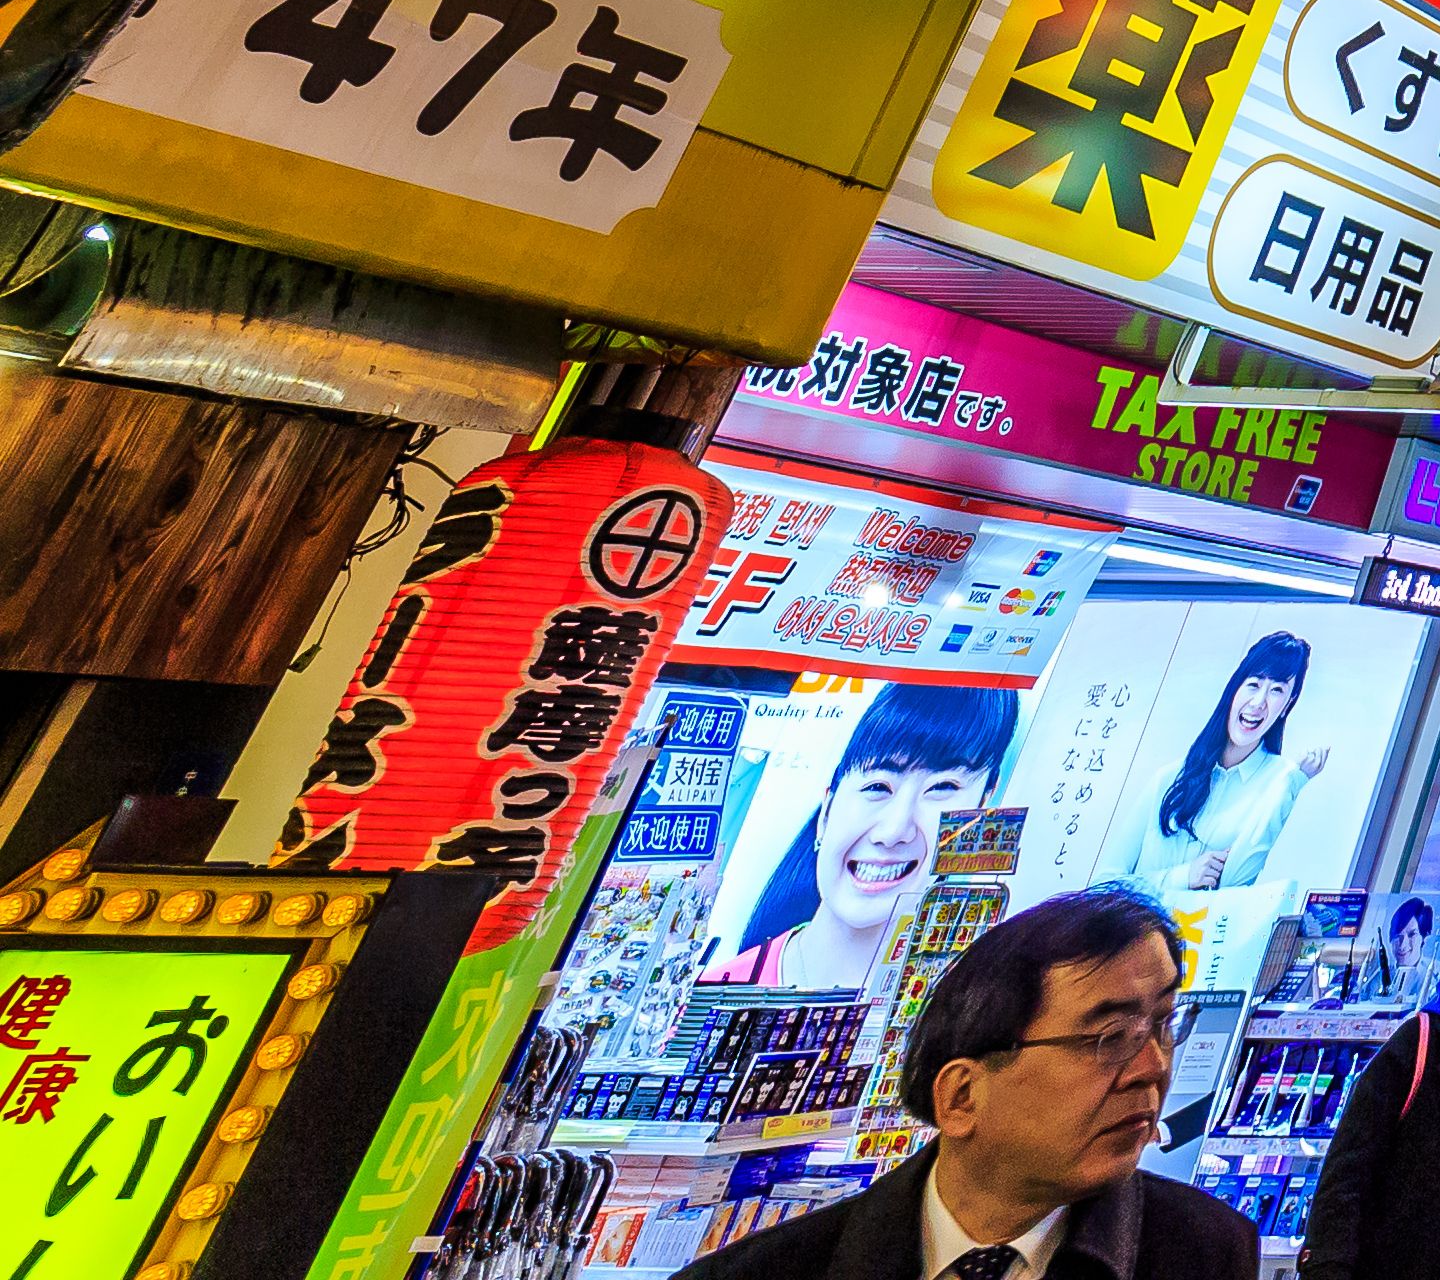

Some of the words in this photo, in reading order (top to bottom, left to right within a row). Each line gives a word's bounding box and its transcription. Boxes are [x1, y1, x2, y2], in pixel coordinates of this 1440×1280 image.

[1249, 190, 1433, 340] 日用品
[1093, 365, 1206, 440] TAX
[1211, 403, 1328, 466] FREE
[1133, 444, 1259, 504] STORE
[853, 507, 976, 563] Welcome
[754, 703, 809, 721] Quality
[815, 705, 844, 719] Life
[667, 787, 717, 803] ALIPAY
[0, 974, 91, 1125] 健康
